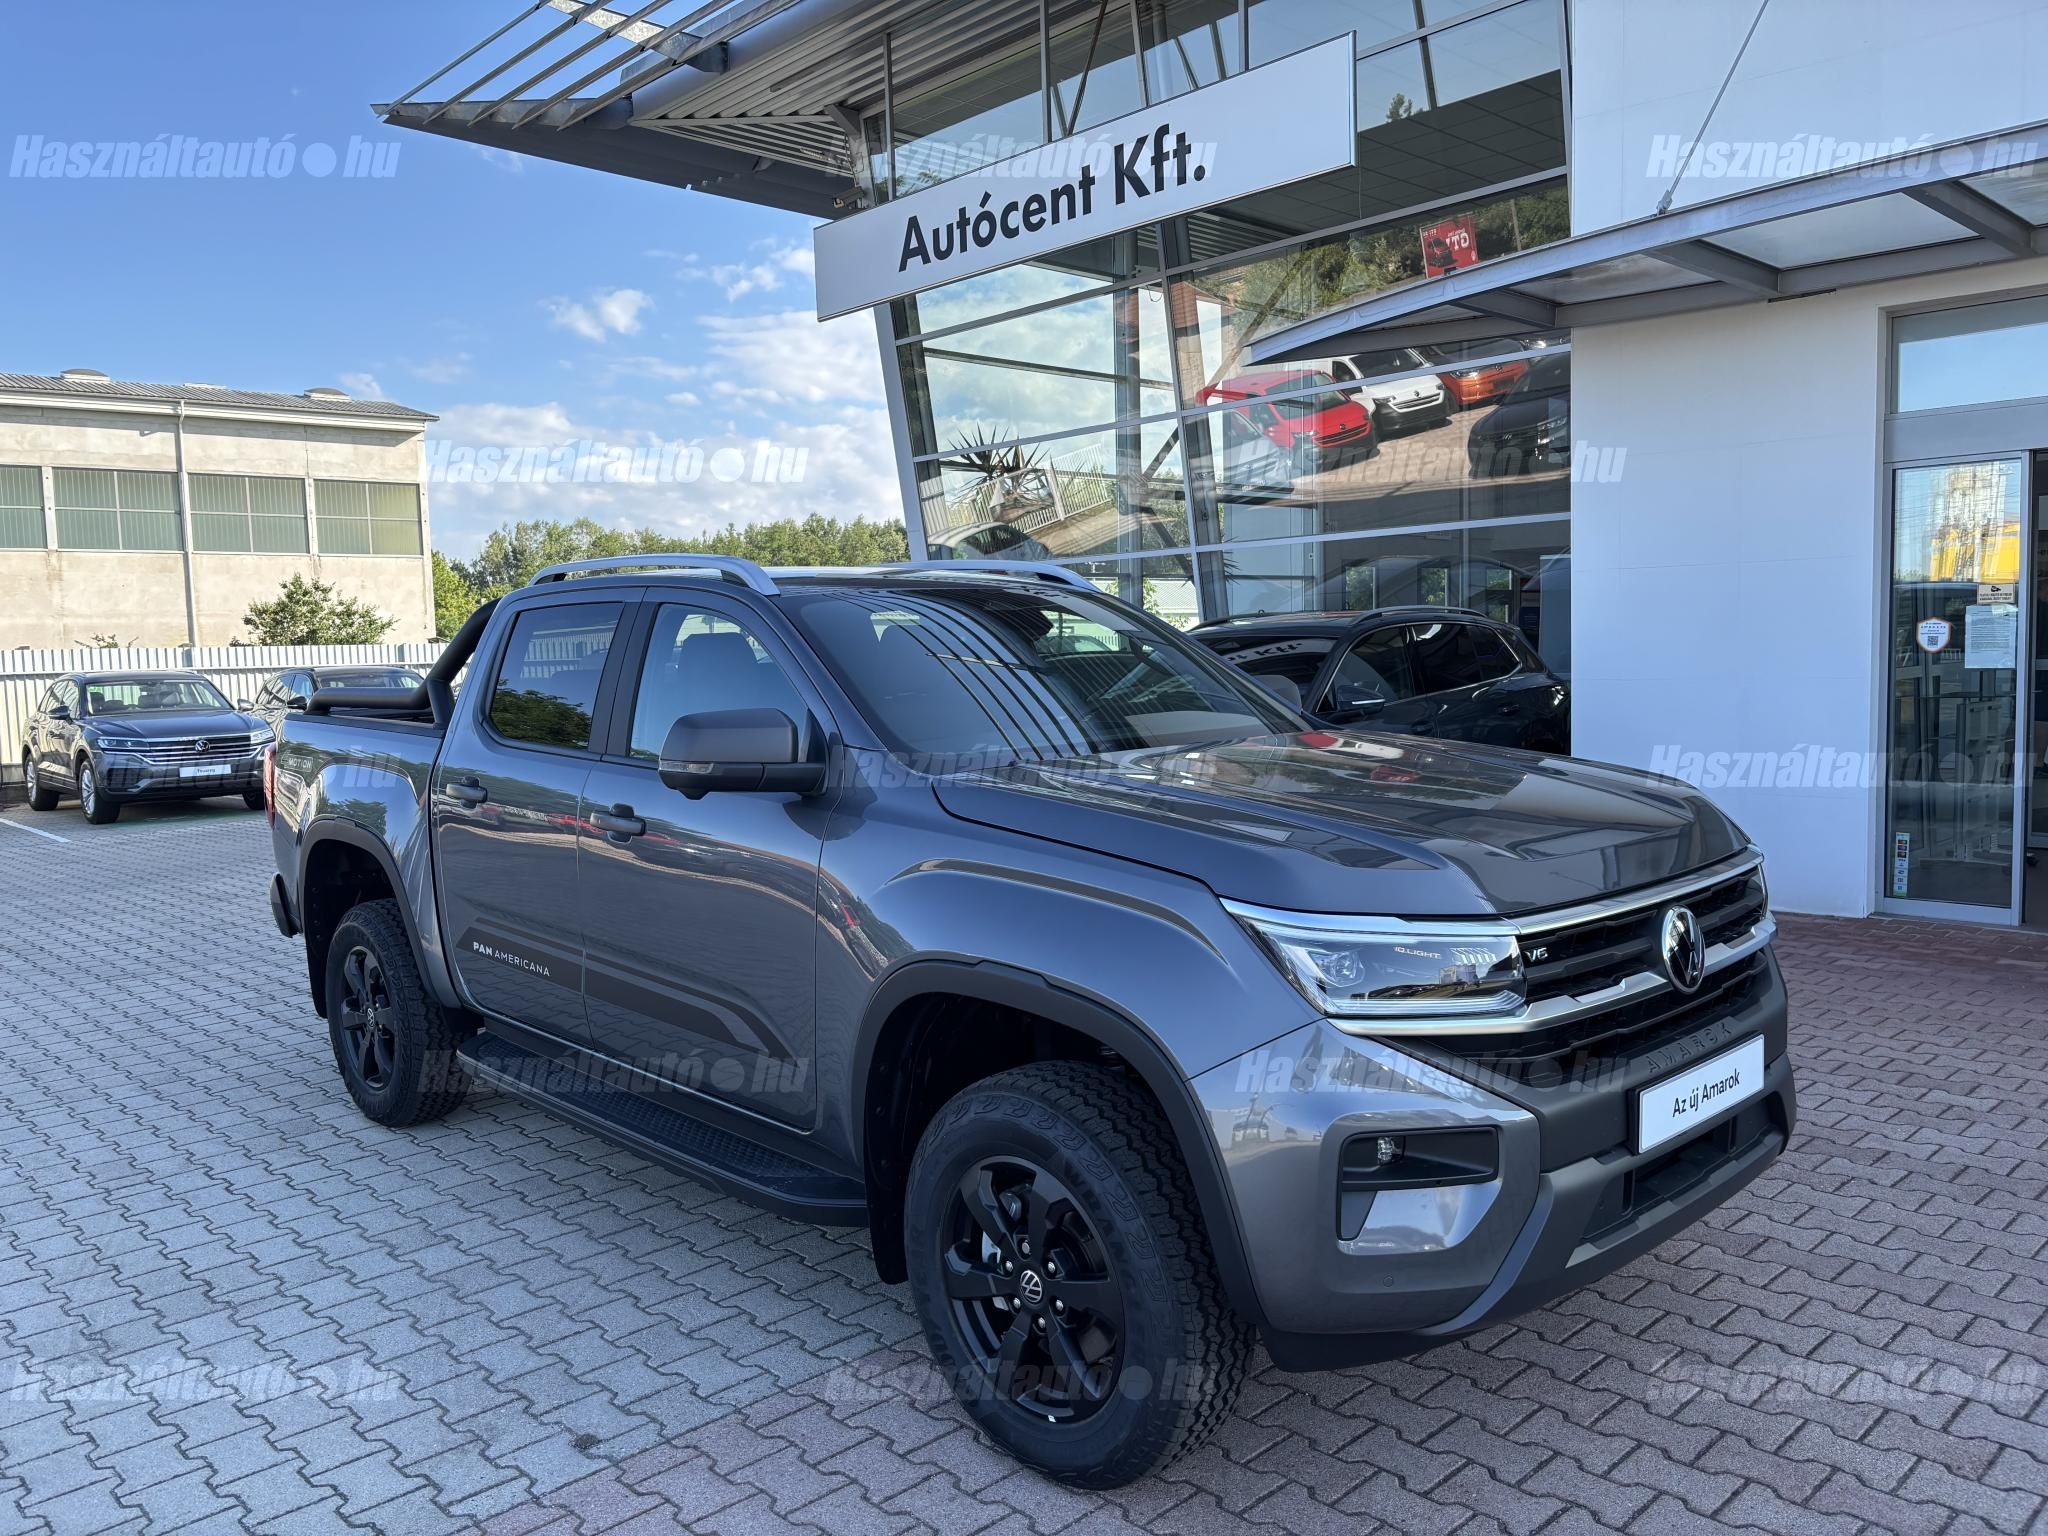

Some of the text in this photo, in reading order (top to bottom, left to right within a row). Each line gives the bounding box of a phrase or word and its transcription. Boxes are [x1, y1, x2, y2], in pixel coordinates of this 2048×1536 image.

[899, 123, 1207, 273] Autócent Kft.
[473, 941, 550, 977] PAN AMERICANA
[1525, 947, 1549, 962] V6
[1672, 1068, 1741, 1118] Az új Amarok
